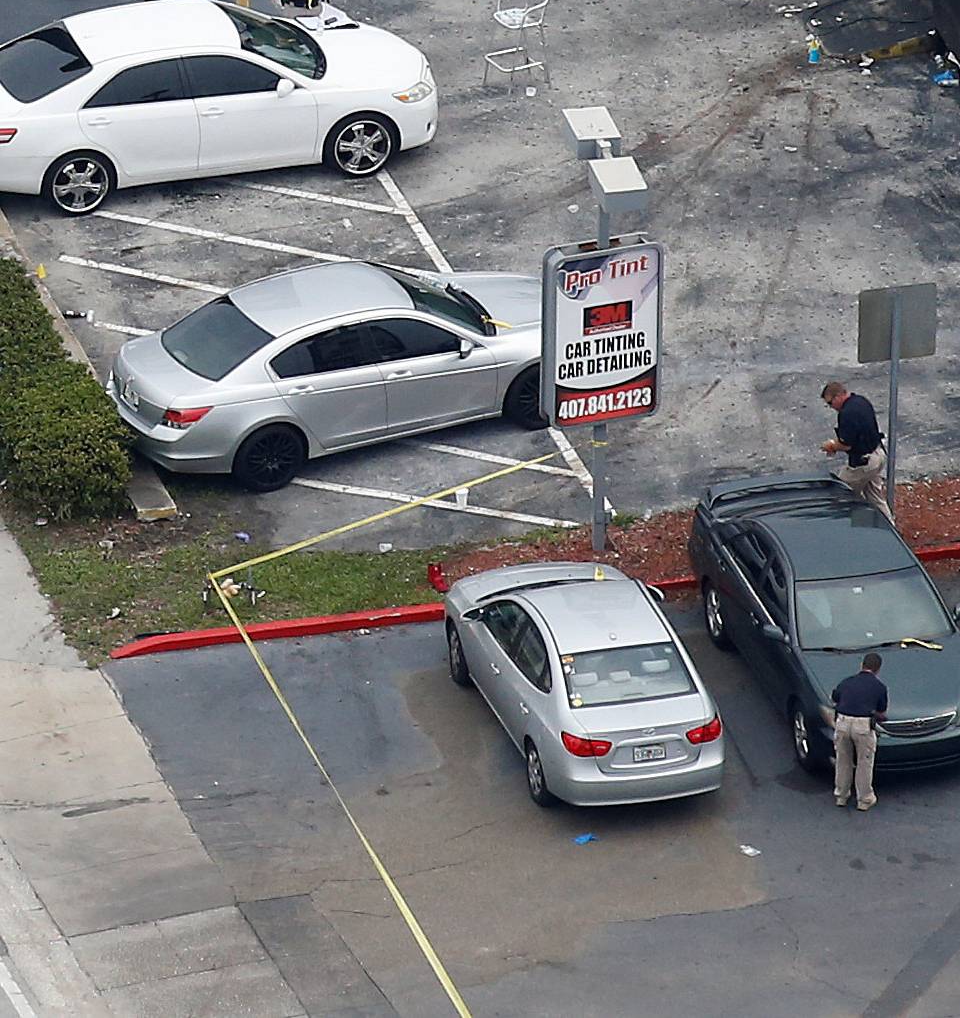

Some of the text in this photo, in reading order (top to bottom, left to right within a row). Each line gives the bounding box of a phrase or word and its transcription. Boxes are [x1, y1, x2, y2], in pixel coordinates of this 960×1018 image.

[564, 255, 649, 293] Pro Tint
[590, 304, 627, 325] 3M
[565, 332, 646, 360] CAR TINTING
[558, 350, 652, 381] CAR DETAILING
[558, 387, 652, 420] 407.841.2123
